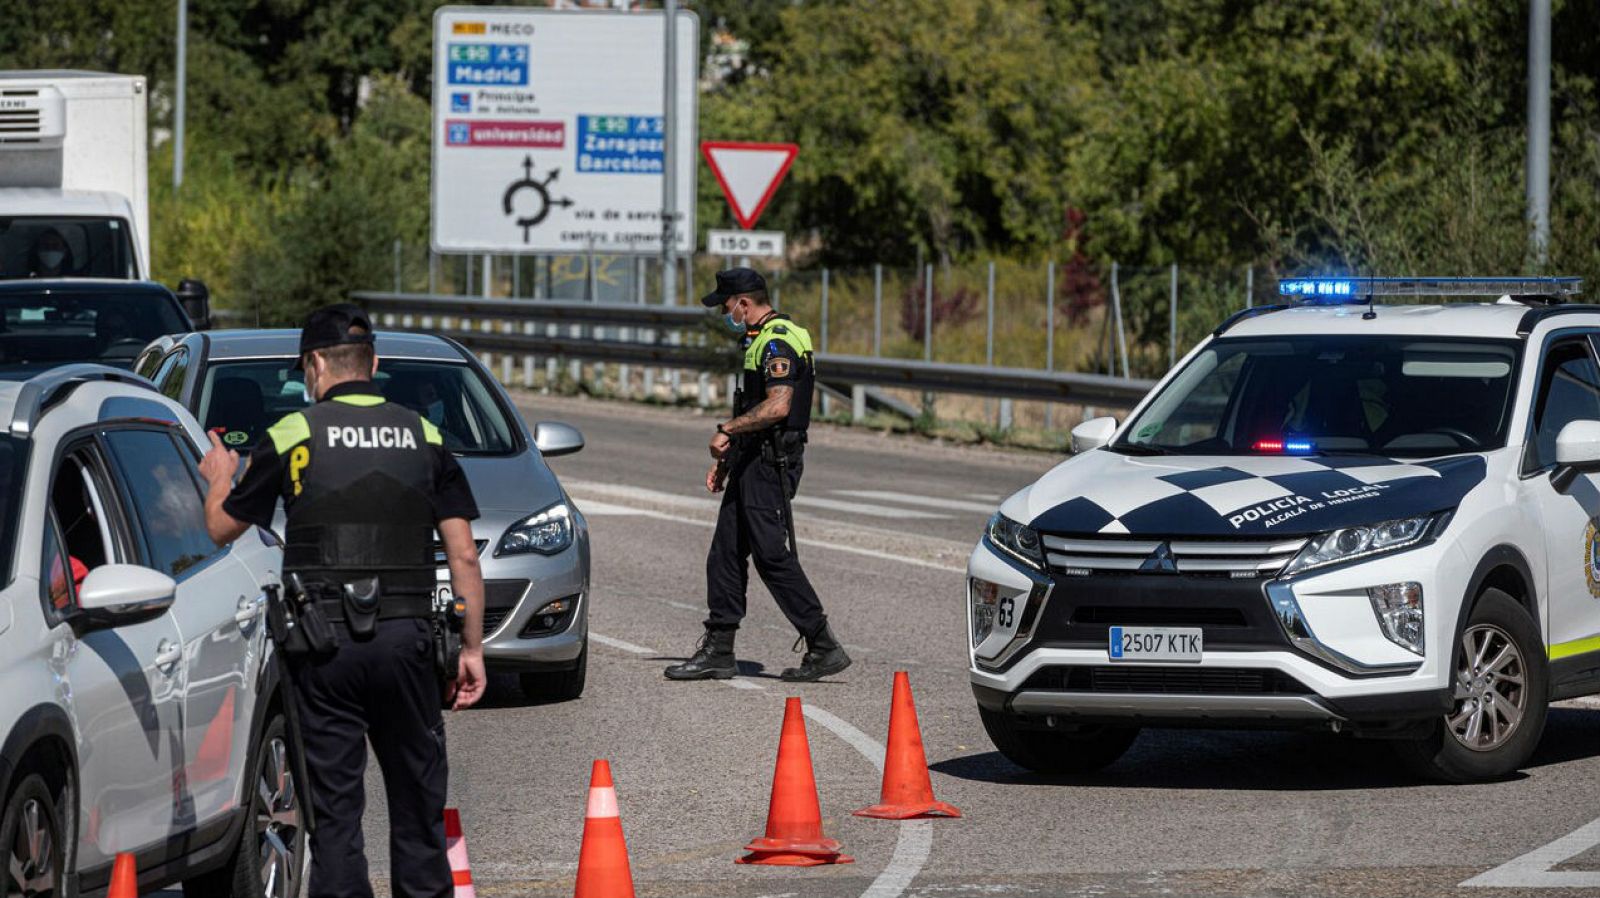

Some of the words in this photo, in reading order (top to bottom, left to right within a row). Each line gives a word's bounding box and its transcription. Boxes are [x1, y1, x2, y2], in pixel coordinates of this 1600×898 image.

[491, 24, 535, 35] MECO
[456, 66, 521, 82] Madrid
[473, 127, 563, 143] universidad
[580, 154, 663, 171] Barcelon
[602, 209, 619, 220] de
[720, 237, 750, 250] 150
[757, 240, 774, 250] m
[327, 426, 417, 449] POLICIA
[1321, 483, 1392, 499] LOCAL
[1309, 501, 1327, 511] DE
[1327, 490, 1382, 507] HENARES
[999, 597, 1015, 628] 63
[1123, 633, 1163, 653] 2507
[1168, 634, 1200, 653] KTK
